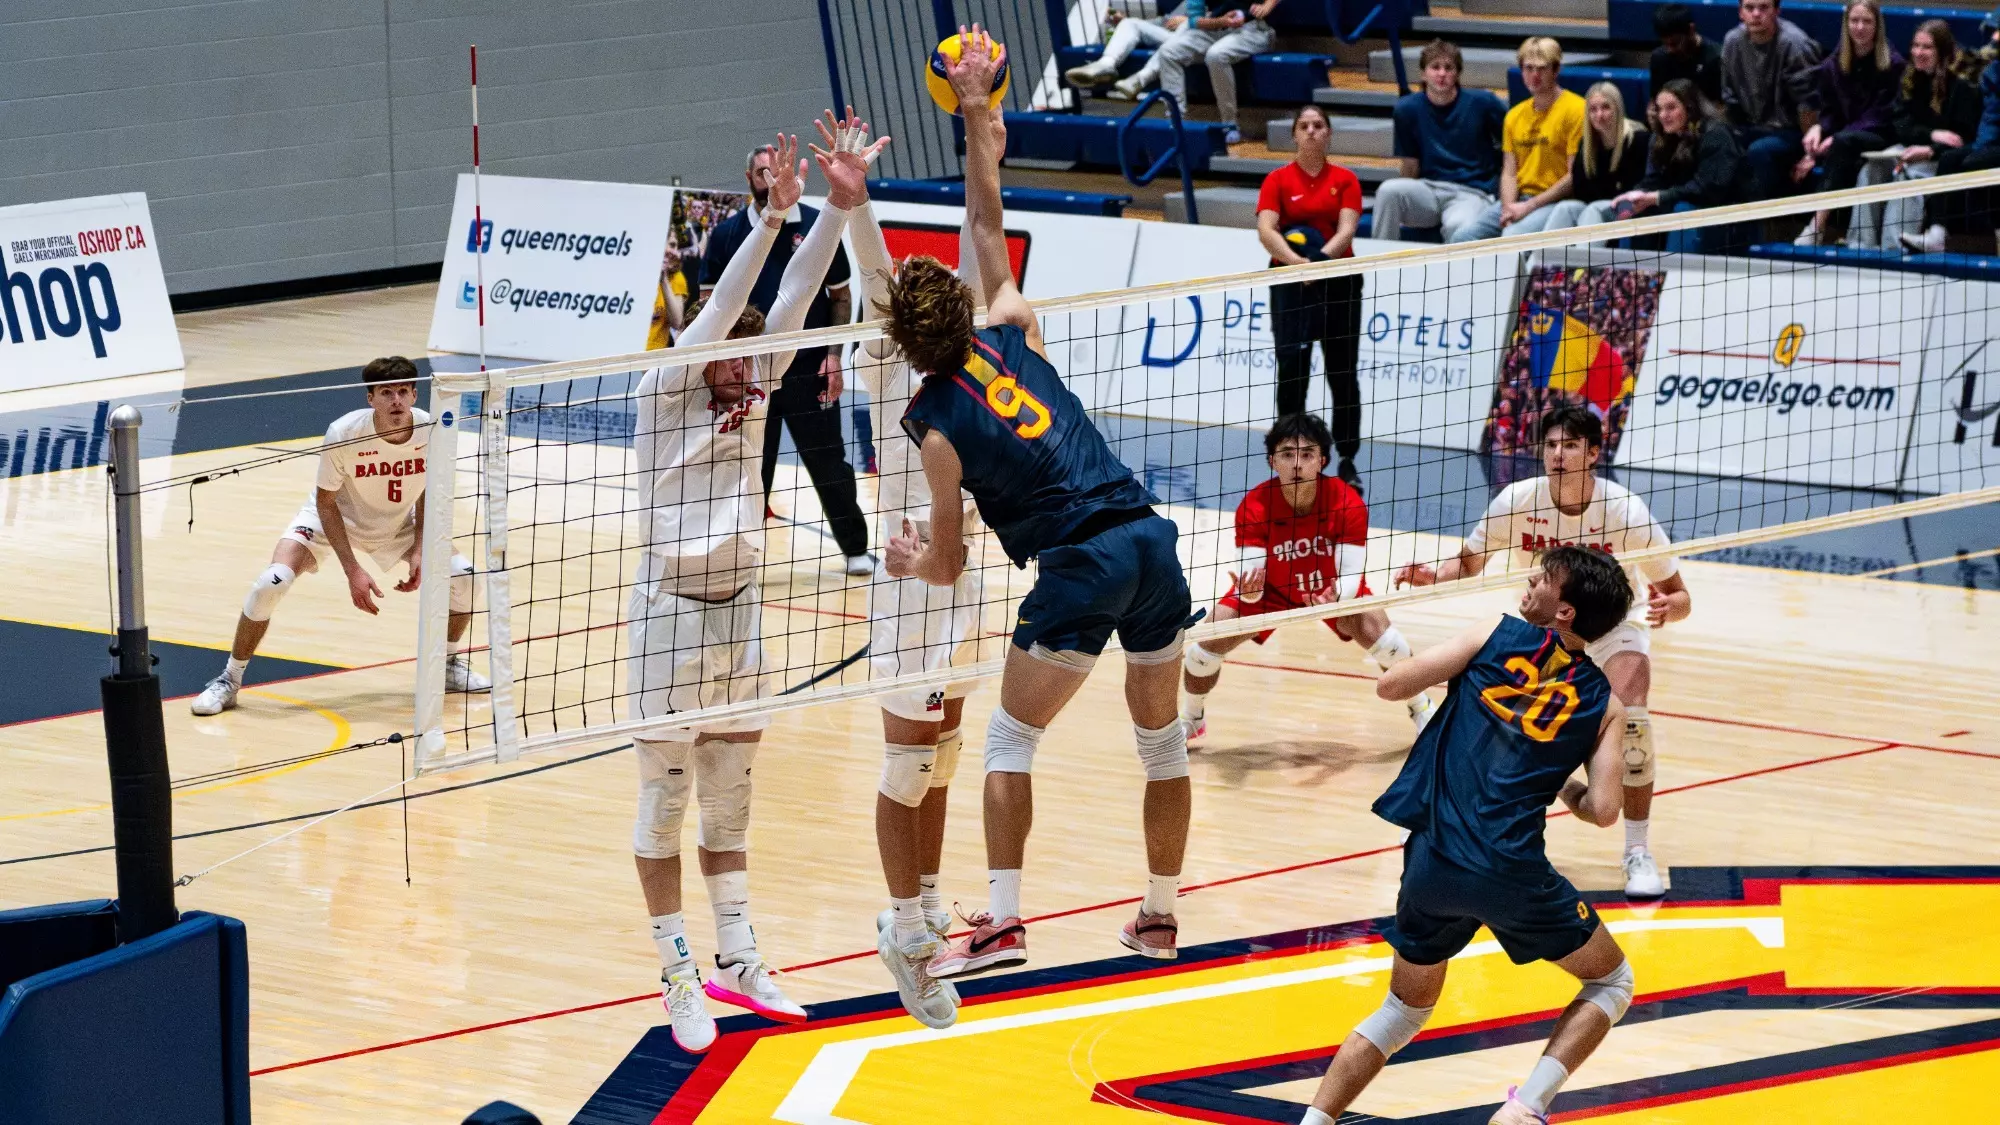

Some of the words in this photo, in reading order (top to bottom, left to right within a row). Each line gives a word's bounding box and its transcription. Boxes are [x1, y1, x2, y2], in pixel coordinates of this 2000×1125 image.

[11, 240, 28, 252] GRAB
[30, 238, 46, 250] YOUR
[47, 235, 75, 248] OFFICIAL
[14, 251, 34, 263] GAELS
[34, 247, 78, 261] MERCHANDISE
[78, 225, 147, 256] QSHOP.CA
[500, 228, 633, 261] queensgaels
[0, 245, 121, 358] hop
[490, 279, 634, 318] @queensgaels
[1367, 312, 1475, 350] OTELS
[1359, 359, 1467, 386] TERFRONT
[986, 374, 1052, 439] 9
[1655, 373, 1895, 414] gogaelsgo.com
[355, 458, 427, 478] BADGER
[387, 480, 402, 503] 6
[1295, 569, 1324, 592] 10
[1480, 656, 1580, 742] 20
